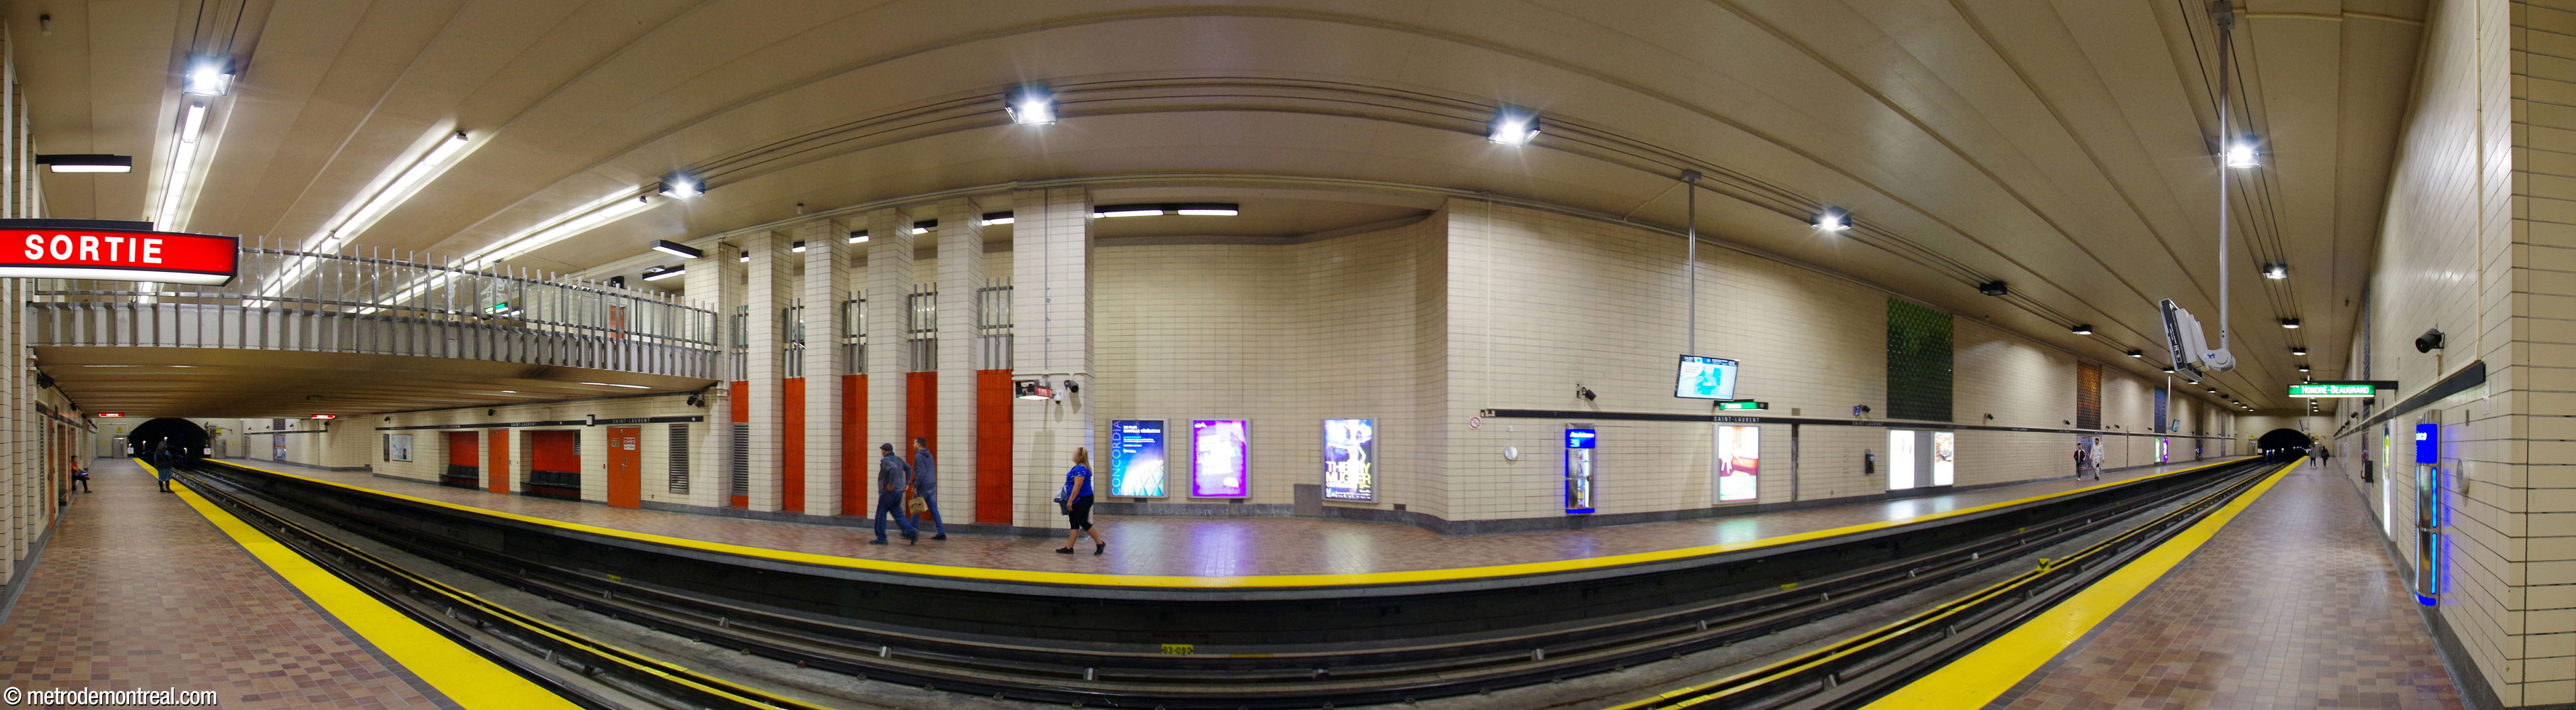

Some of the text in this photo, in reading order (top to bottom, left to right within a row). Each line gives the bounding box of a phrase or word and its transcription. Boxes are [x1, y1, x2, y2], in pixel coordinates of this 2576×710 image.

[25, 234, 163, 263] SORTIE
[1112, 420, 1122, 496] CONCORDIA
[1326, 461, 1371, 474] THIERY
[1326, 471, 1371, 485] MUGER
